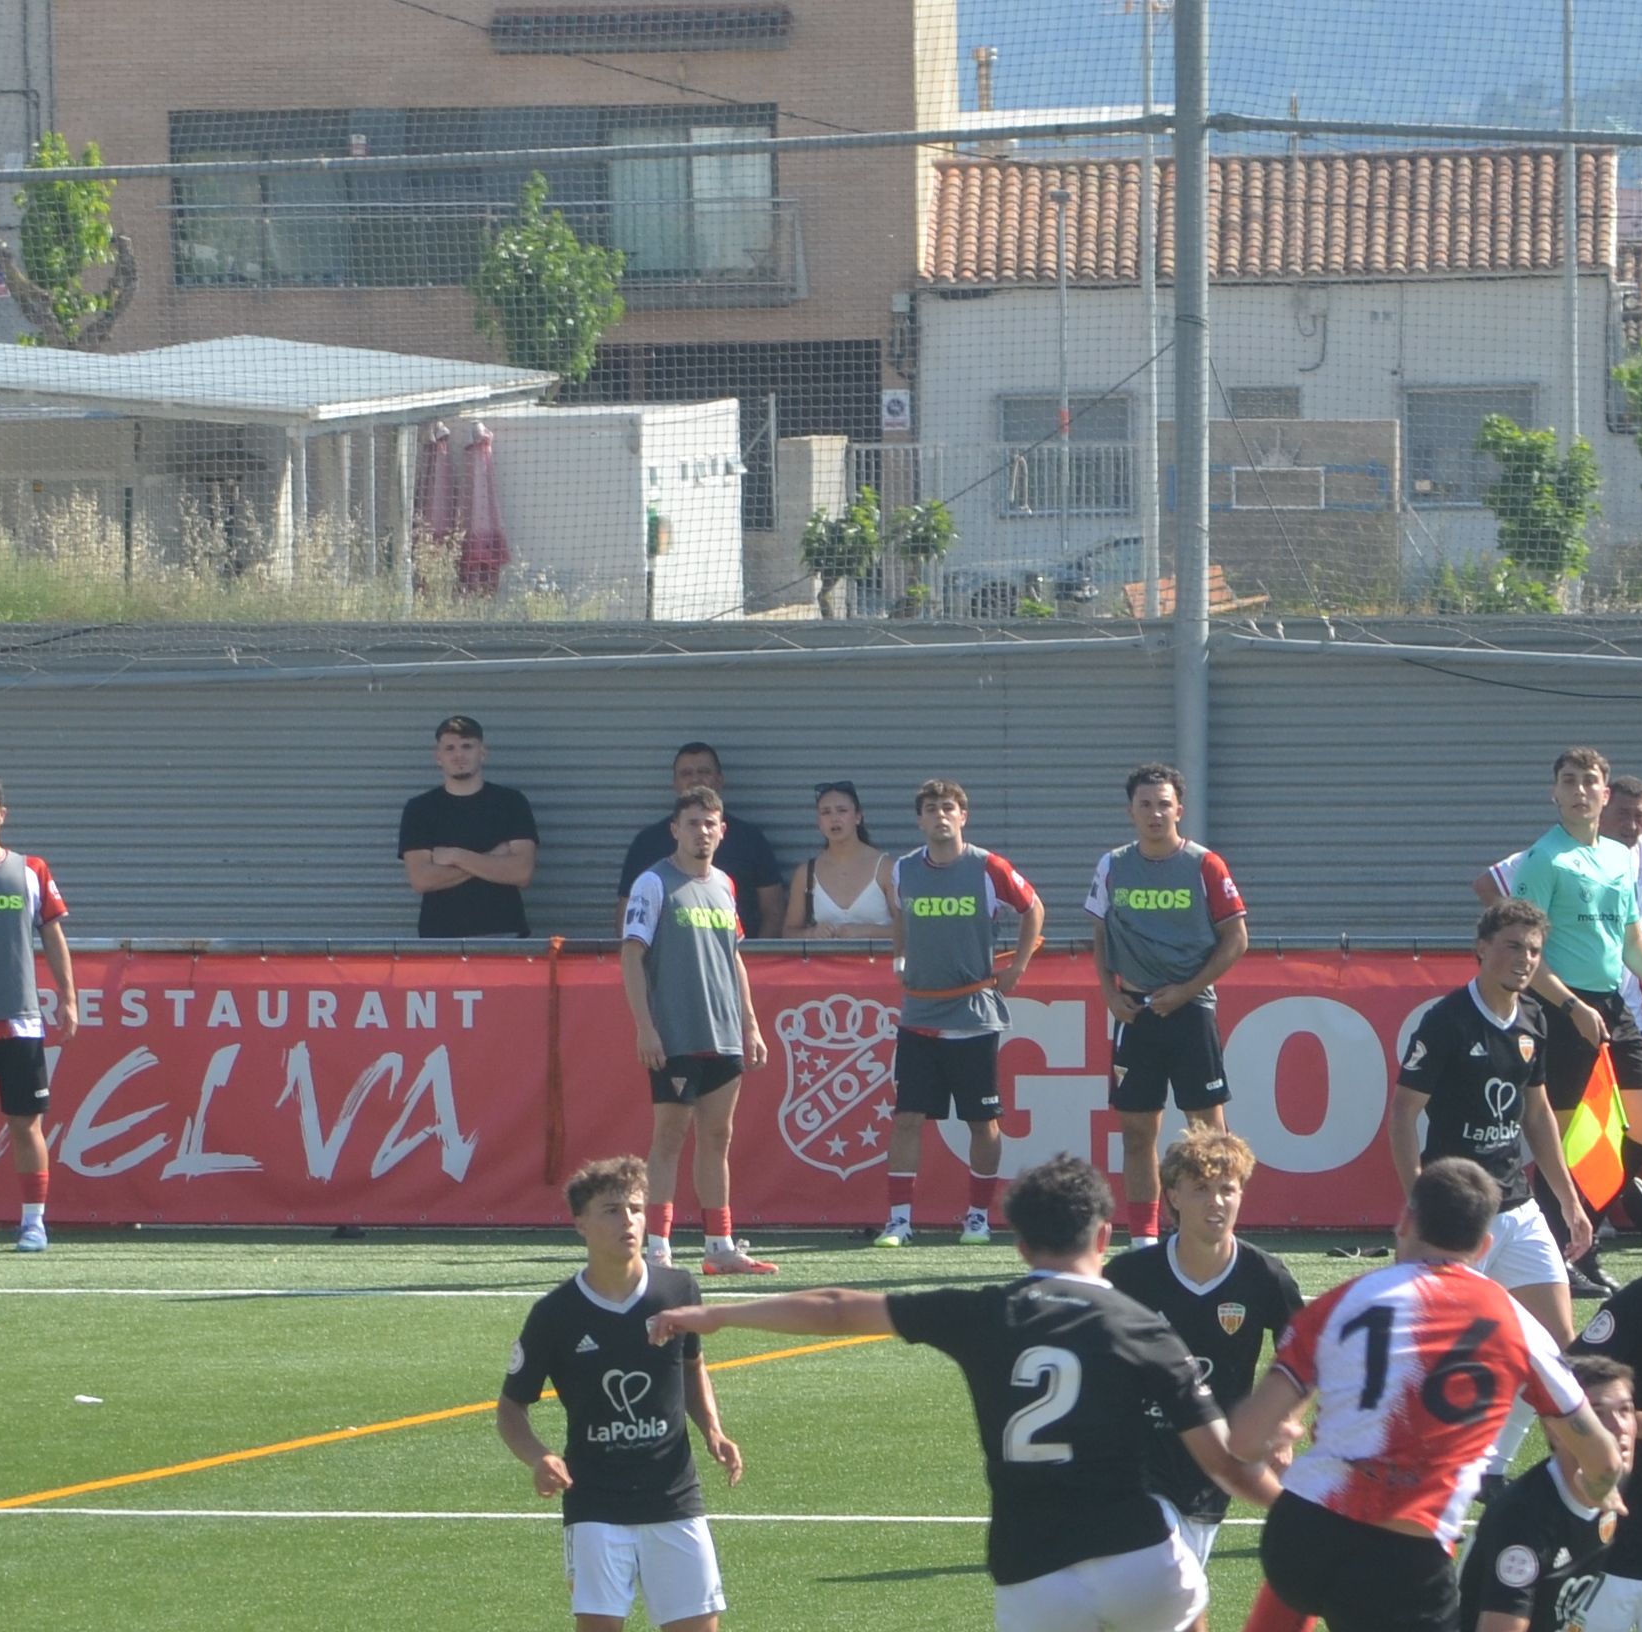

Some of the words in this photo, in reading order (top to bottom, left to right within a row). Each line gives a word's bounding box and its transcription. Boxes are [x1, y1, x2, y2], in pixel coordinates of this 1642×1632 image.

[914, 896, 976, 916] GIOS
[1128, 888, 1191, 910] GIOS
[690, 907, 736, 930] GIOS
[37, 988, 483, 1029] RESTAURANT
[795, 1050, 886, 1131] GIOS
[1339, 1305, 1500, 1425] 16
[1002, 1345, 1083, 1465] 2
[587, 1416, 668, 1442] LaPobla
